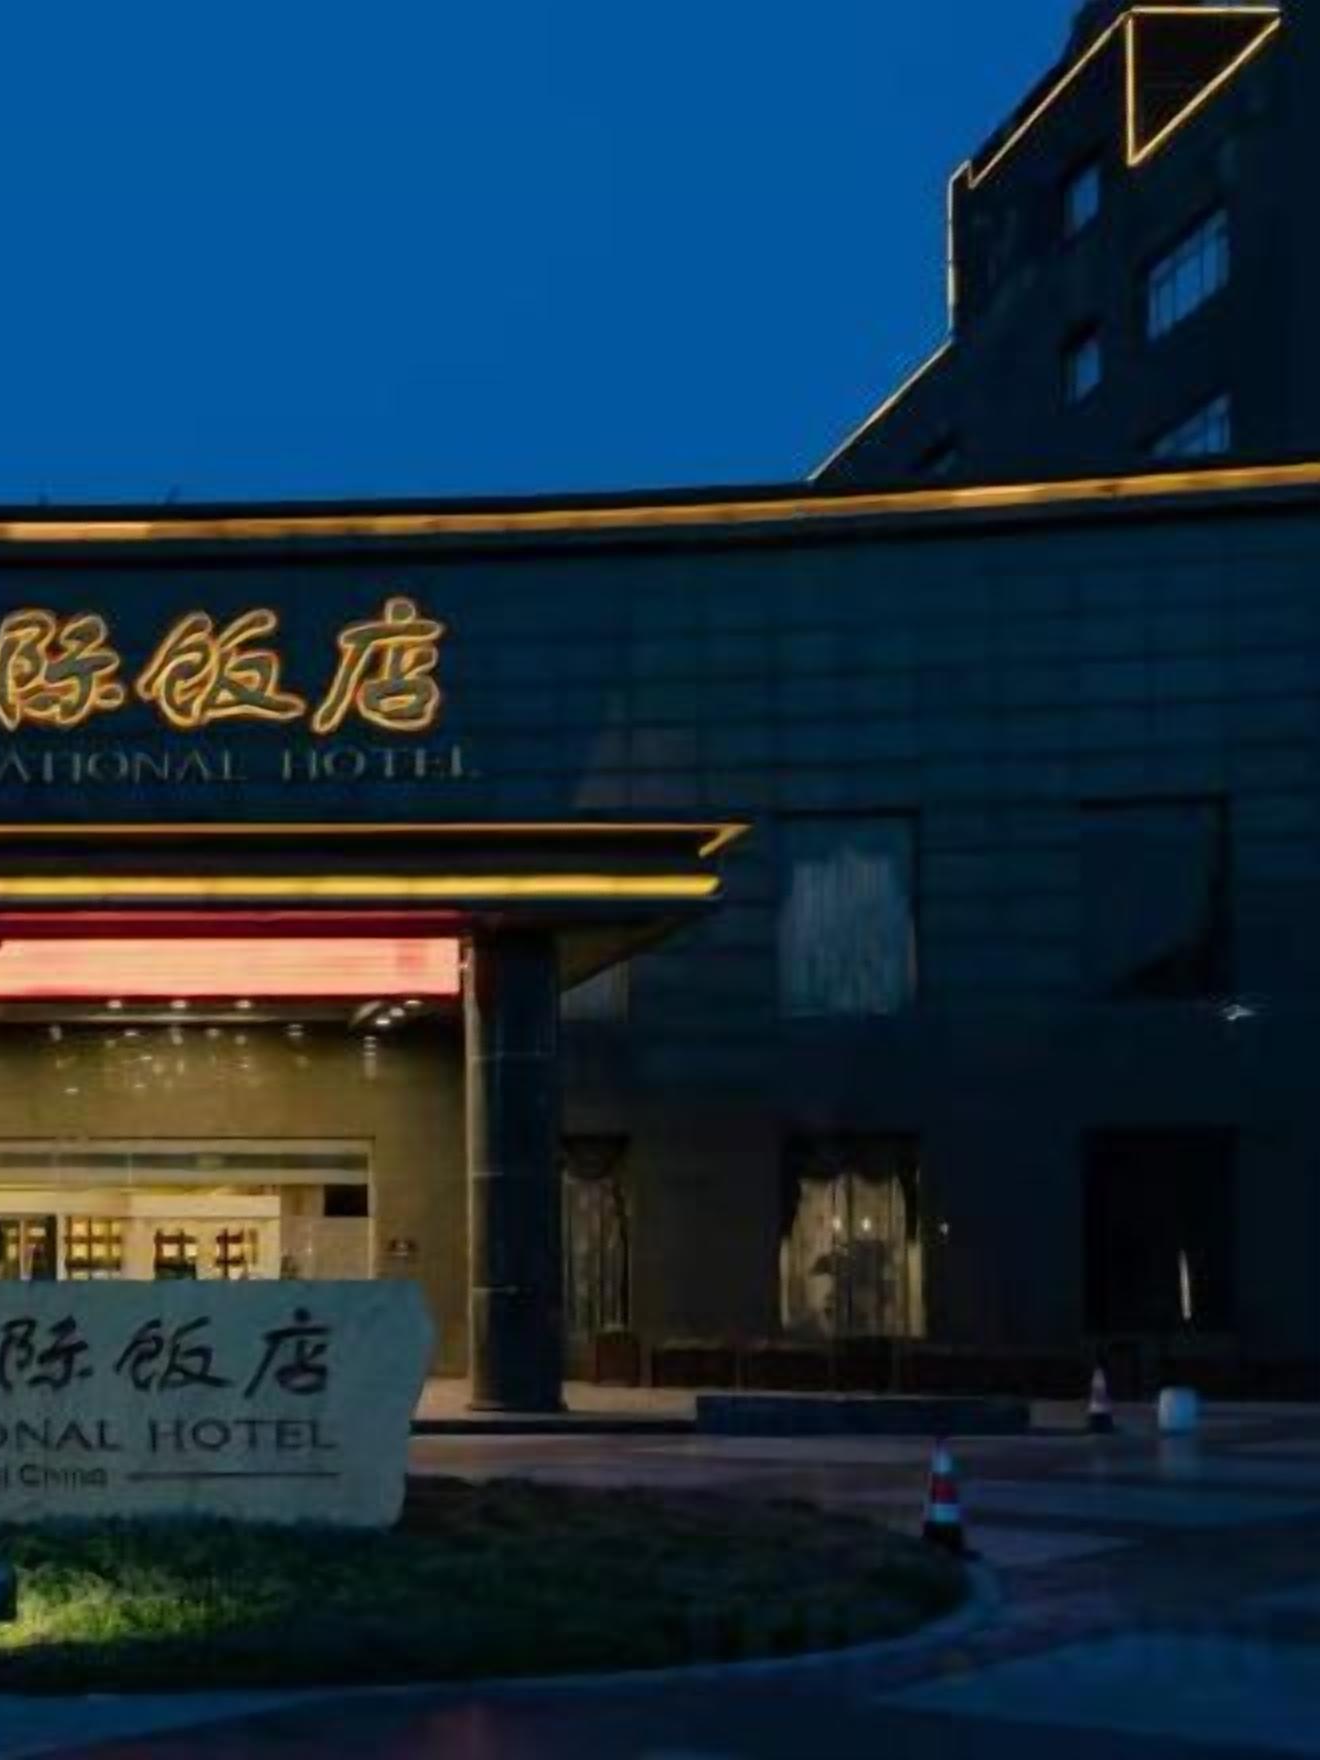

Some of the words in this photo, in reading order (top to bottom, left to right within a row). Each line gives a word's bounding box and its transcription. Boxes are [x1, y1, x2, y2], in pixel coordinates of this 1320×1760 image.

[281, 744, 483, 781] HOTEL
[149, 1418, 337, 1452] HOTEL
[19, 1464, 108, 1489] China
